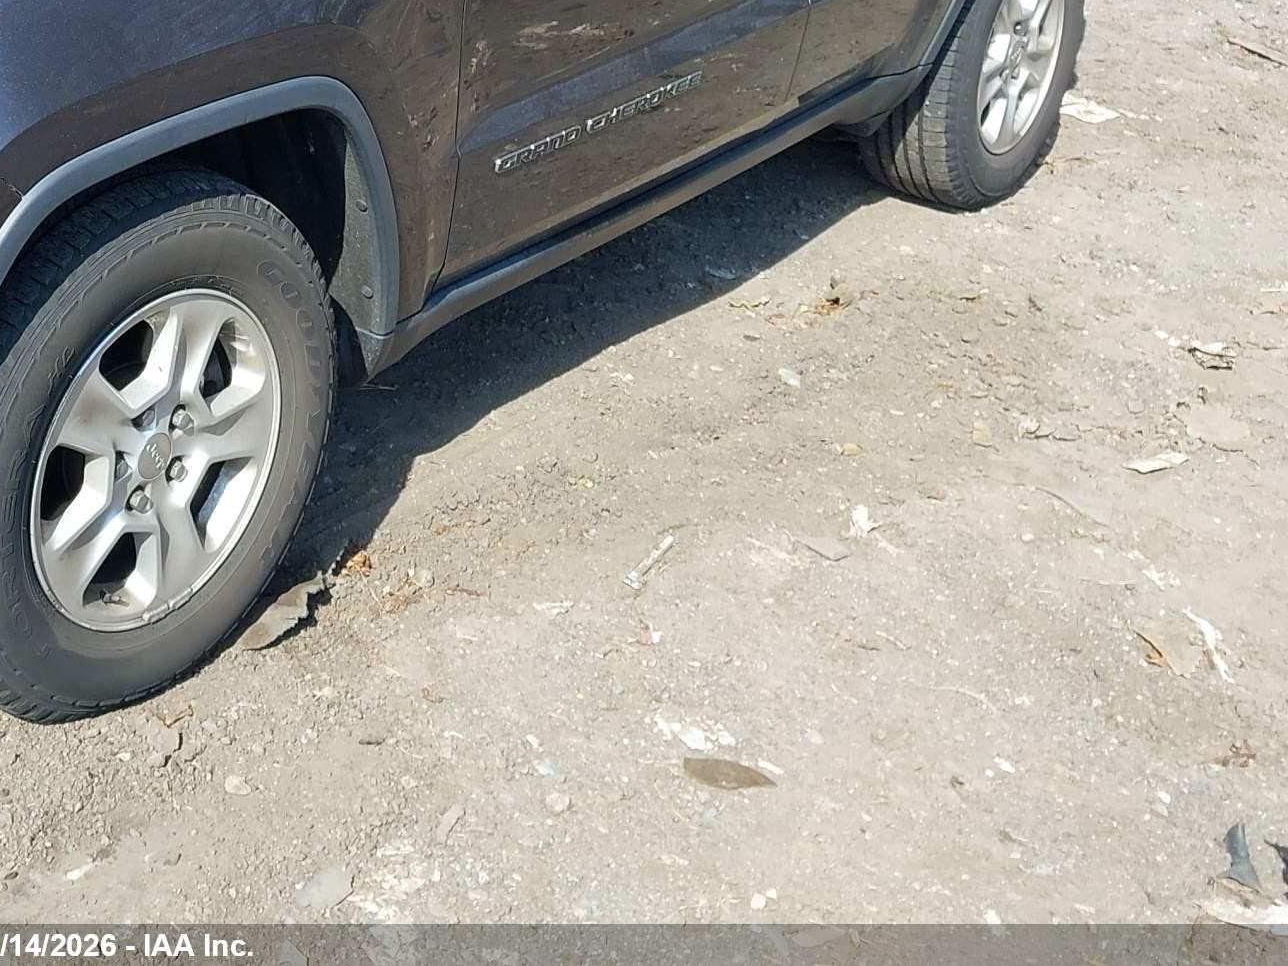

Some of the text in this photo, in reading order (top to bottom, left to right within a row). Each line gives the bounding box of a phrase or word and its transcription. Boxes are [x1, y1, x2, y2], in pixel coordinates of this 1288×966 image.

[494, 69, 703, 174] GRAND CHEROKEE
[145, 442, 167, 470] Jeep
